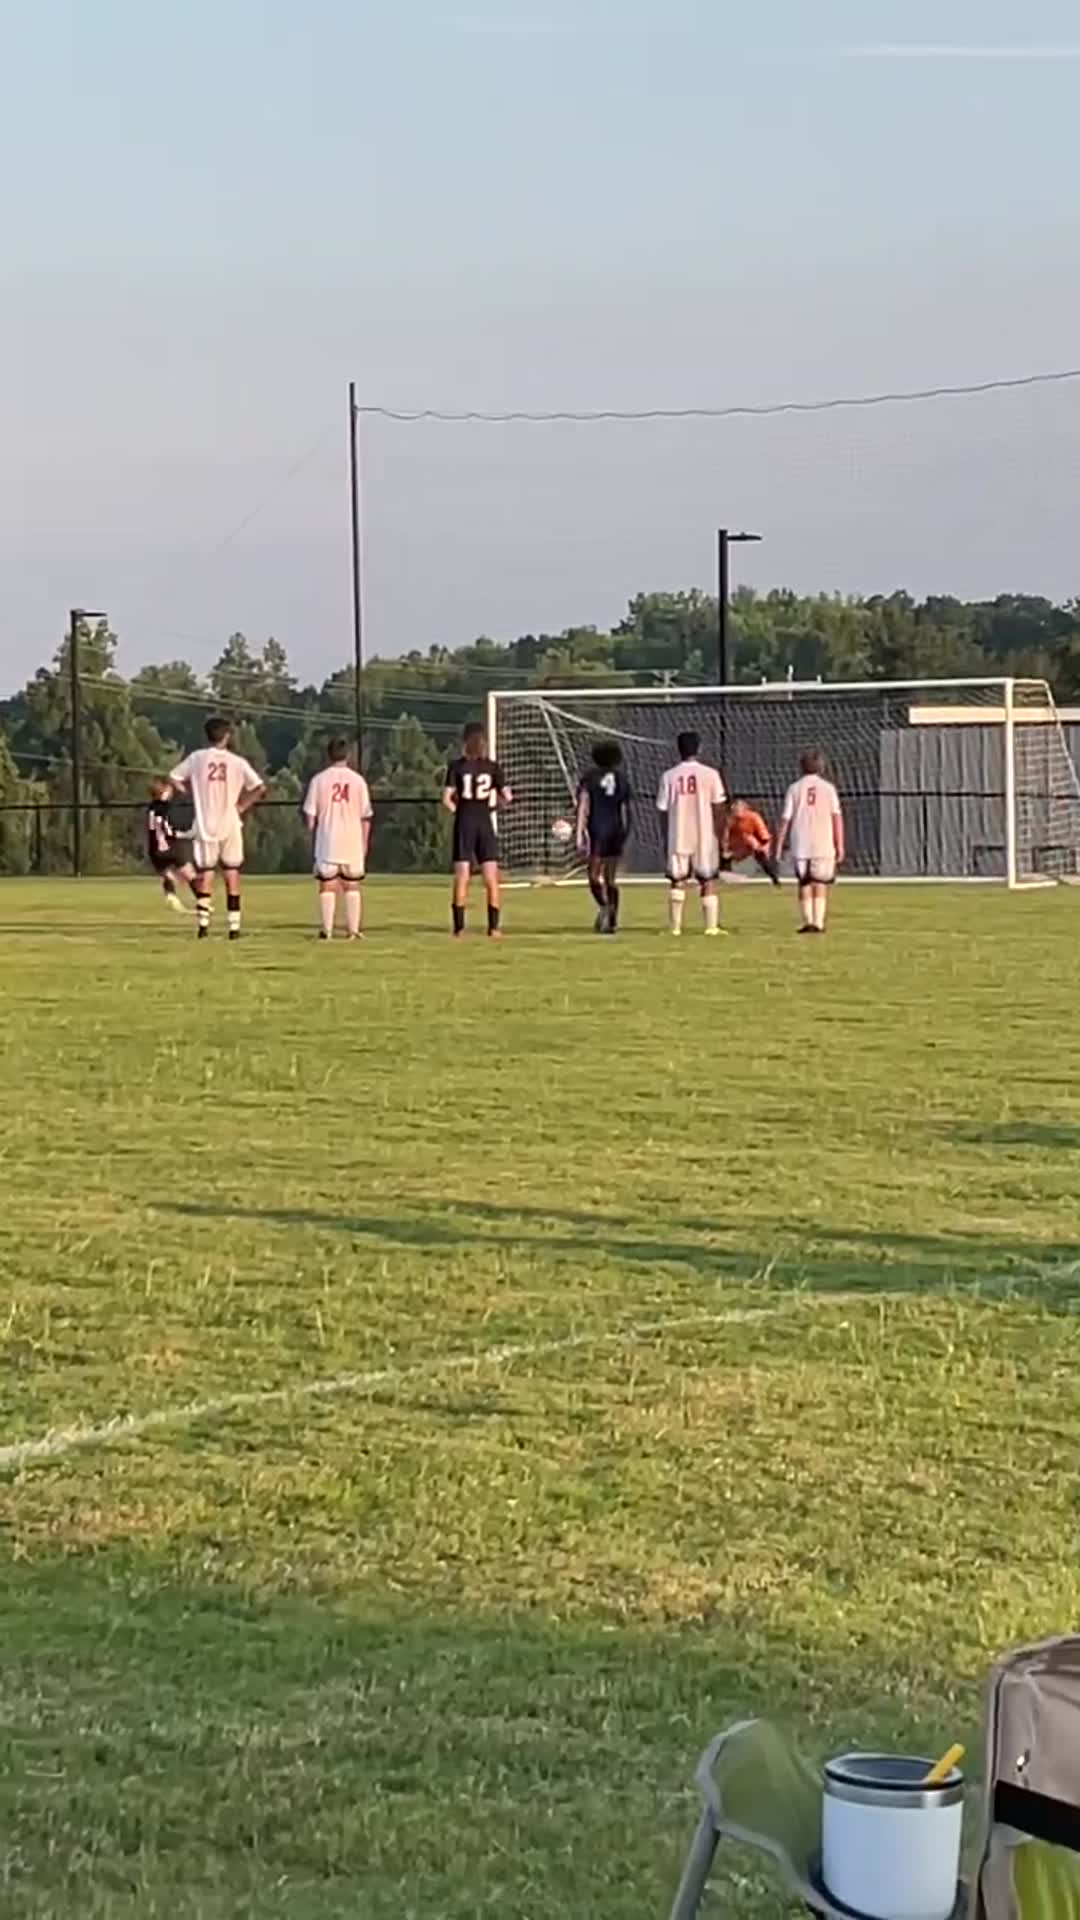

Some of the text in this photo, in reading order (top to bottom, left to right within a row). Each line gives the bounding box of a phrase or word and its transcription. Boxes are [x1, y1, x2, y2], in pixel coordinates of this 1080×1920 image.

[208, 762, 227, 781] 23
[332, 783, 350, 803] 24
[462, 773, 493, 799] 12
[678, 775, 697, 795] 18
